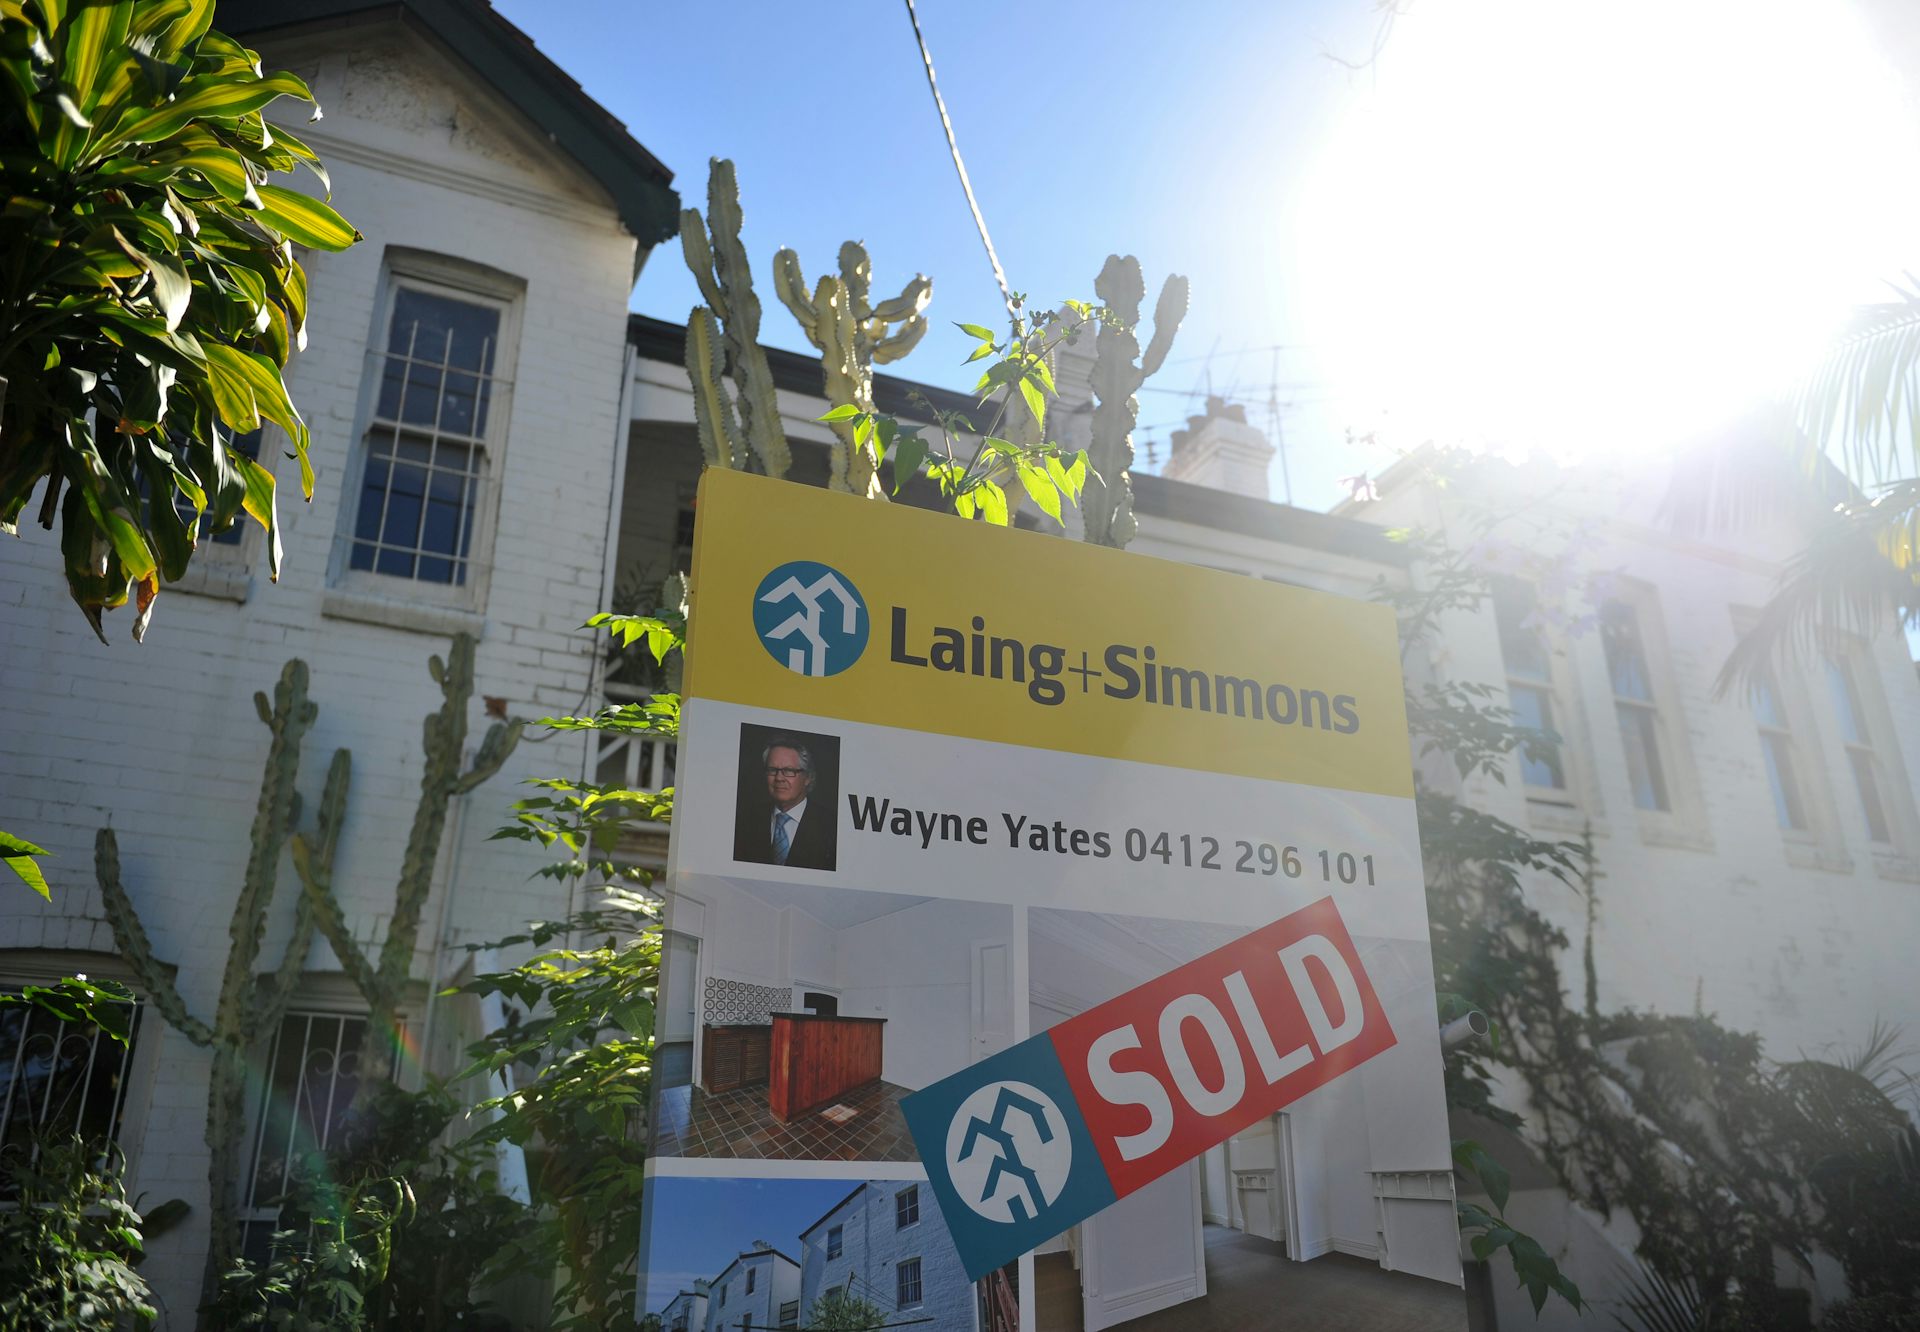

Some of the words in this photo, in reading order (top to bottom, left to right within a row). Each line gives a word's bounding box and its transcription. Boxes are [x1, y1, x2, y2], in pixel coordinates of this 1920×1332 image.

[890, 605, 1360, 735] Laing+Simmons
[848, 794, 988, 849] Wayne
[1002, 813, 1111, 858] Yates
[1124, 827, 1220, 871] 0412
[1235, 841, 1302, 879] 296
[1318, 850, 1376, 886] 101
[1087, 933, 1366, 1162] SOLD
